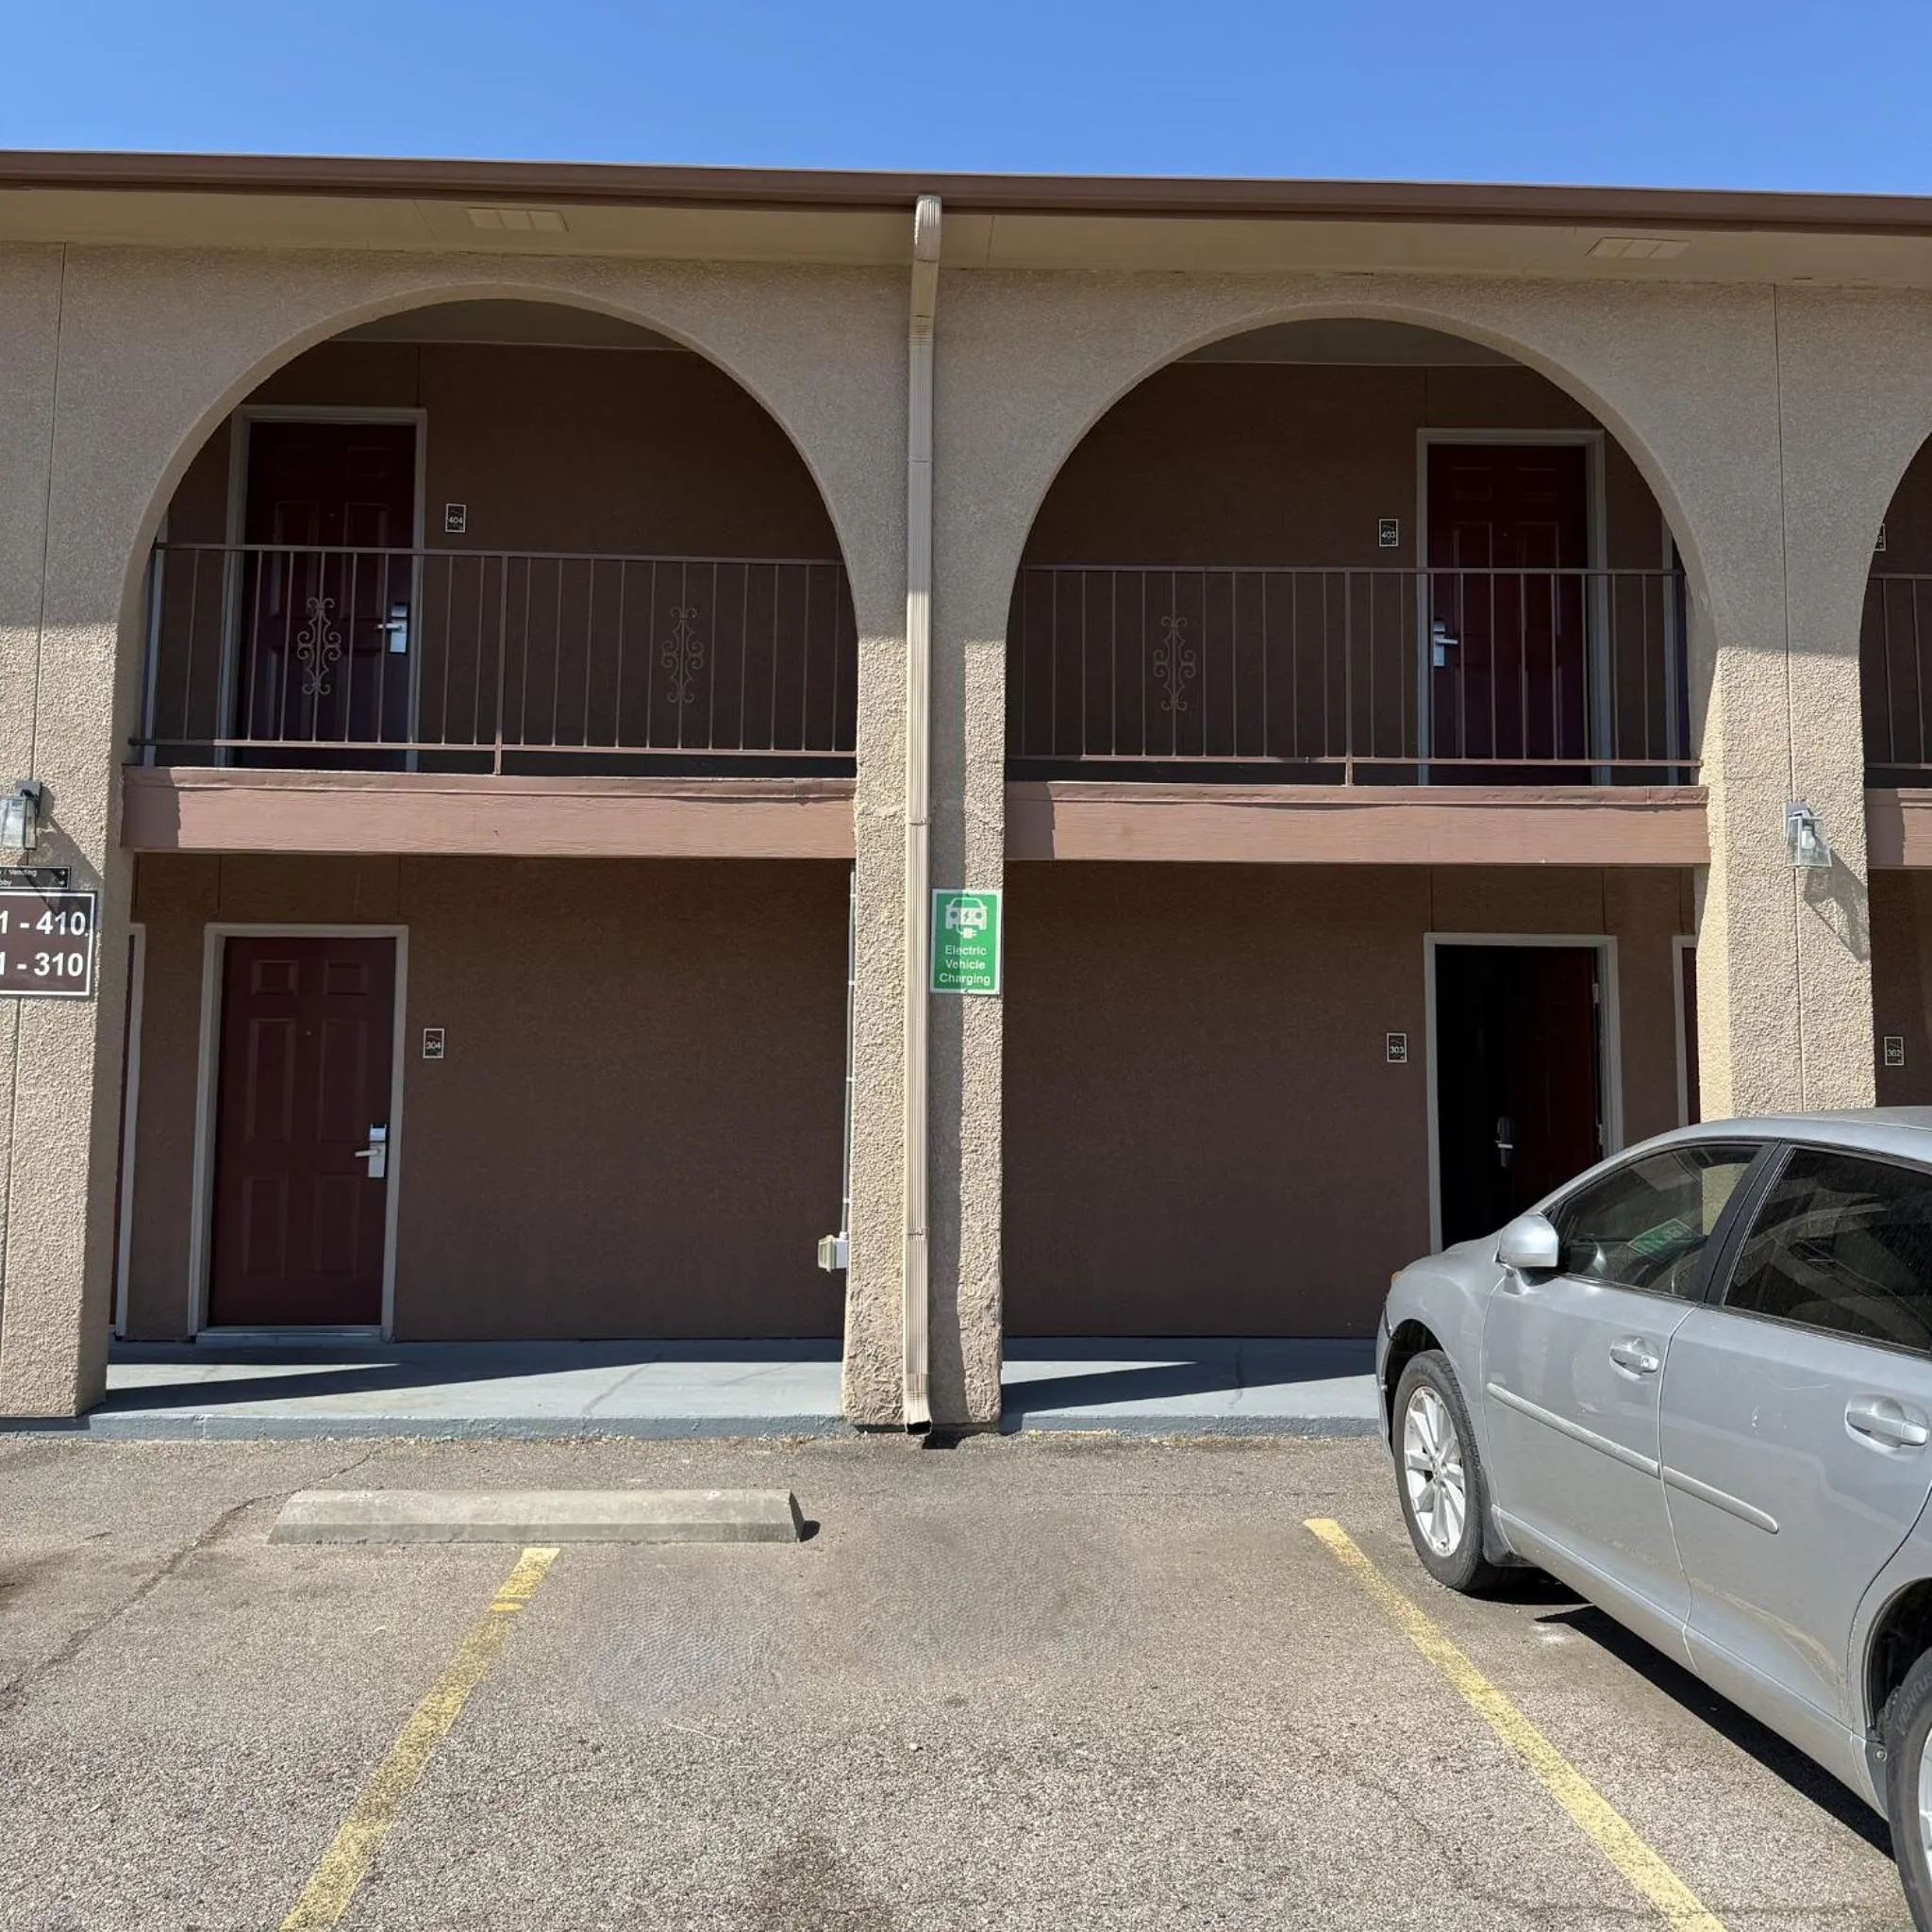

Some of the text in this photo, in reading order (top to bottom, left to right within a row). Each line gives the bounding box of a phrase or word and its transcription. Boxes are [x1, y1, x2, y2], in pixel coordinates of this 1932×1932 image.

[448, 516, 463, 525] 404
[1381, 530, 1396, 539] 403
[36, 910, 86, 936] 410
[944, 944, 988, 956] Electric
[33, 952, 84, 977] 310
[945, 959, 987, 970] Vehicle
[939, 973, 991, 986] Charging
[425, 1041, 441, 1049] 304
[1390, 1045, 1405, 1054] 303
[1887, 1049, 1902, 1058] 302
